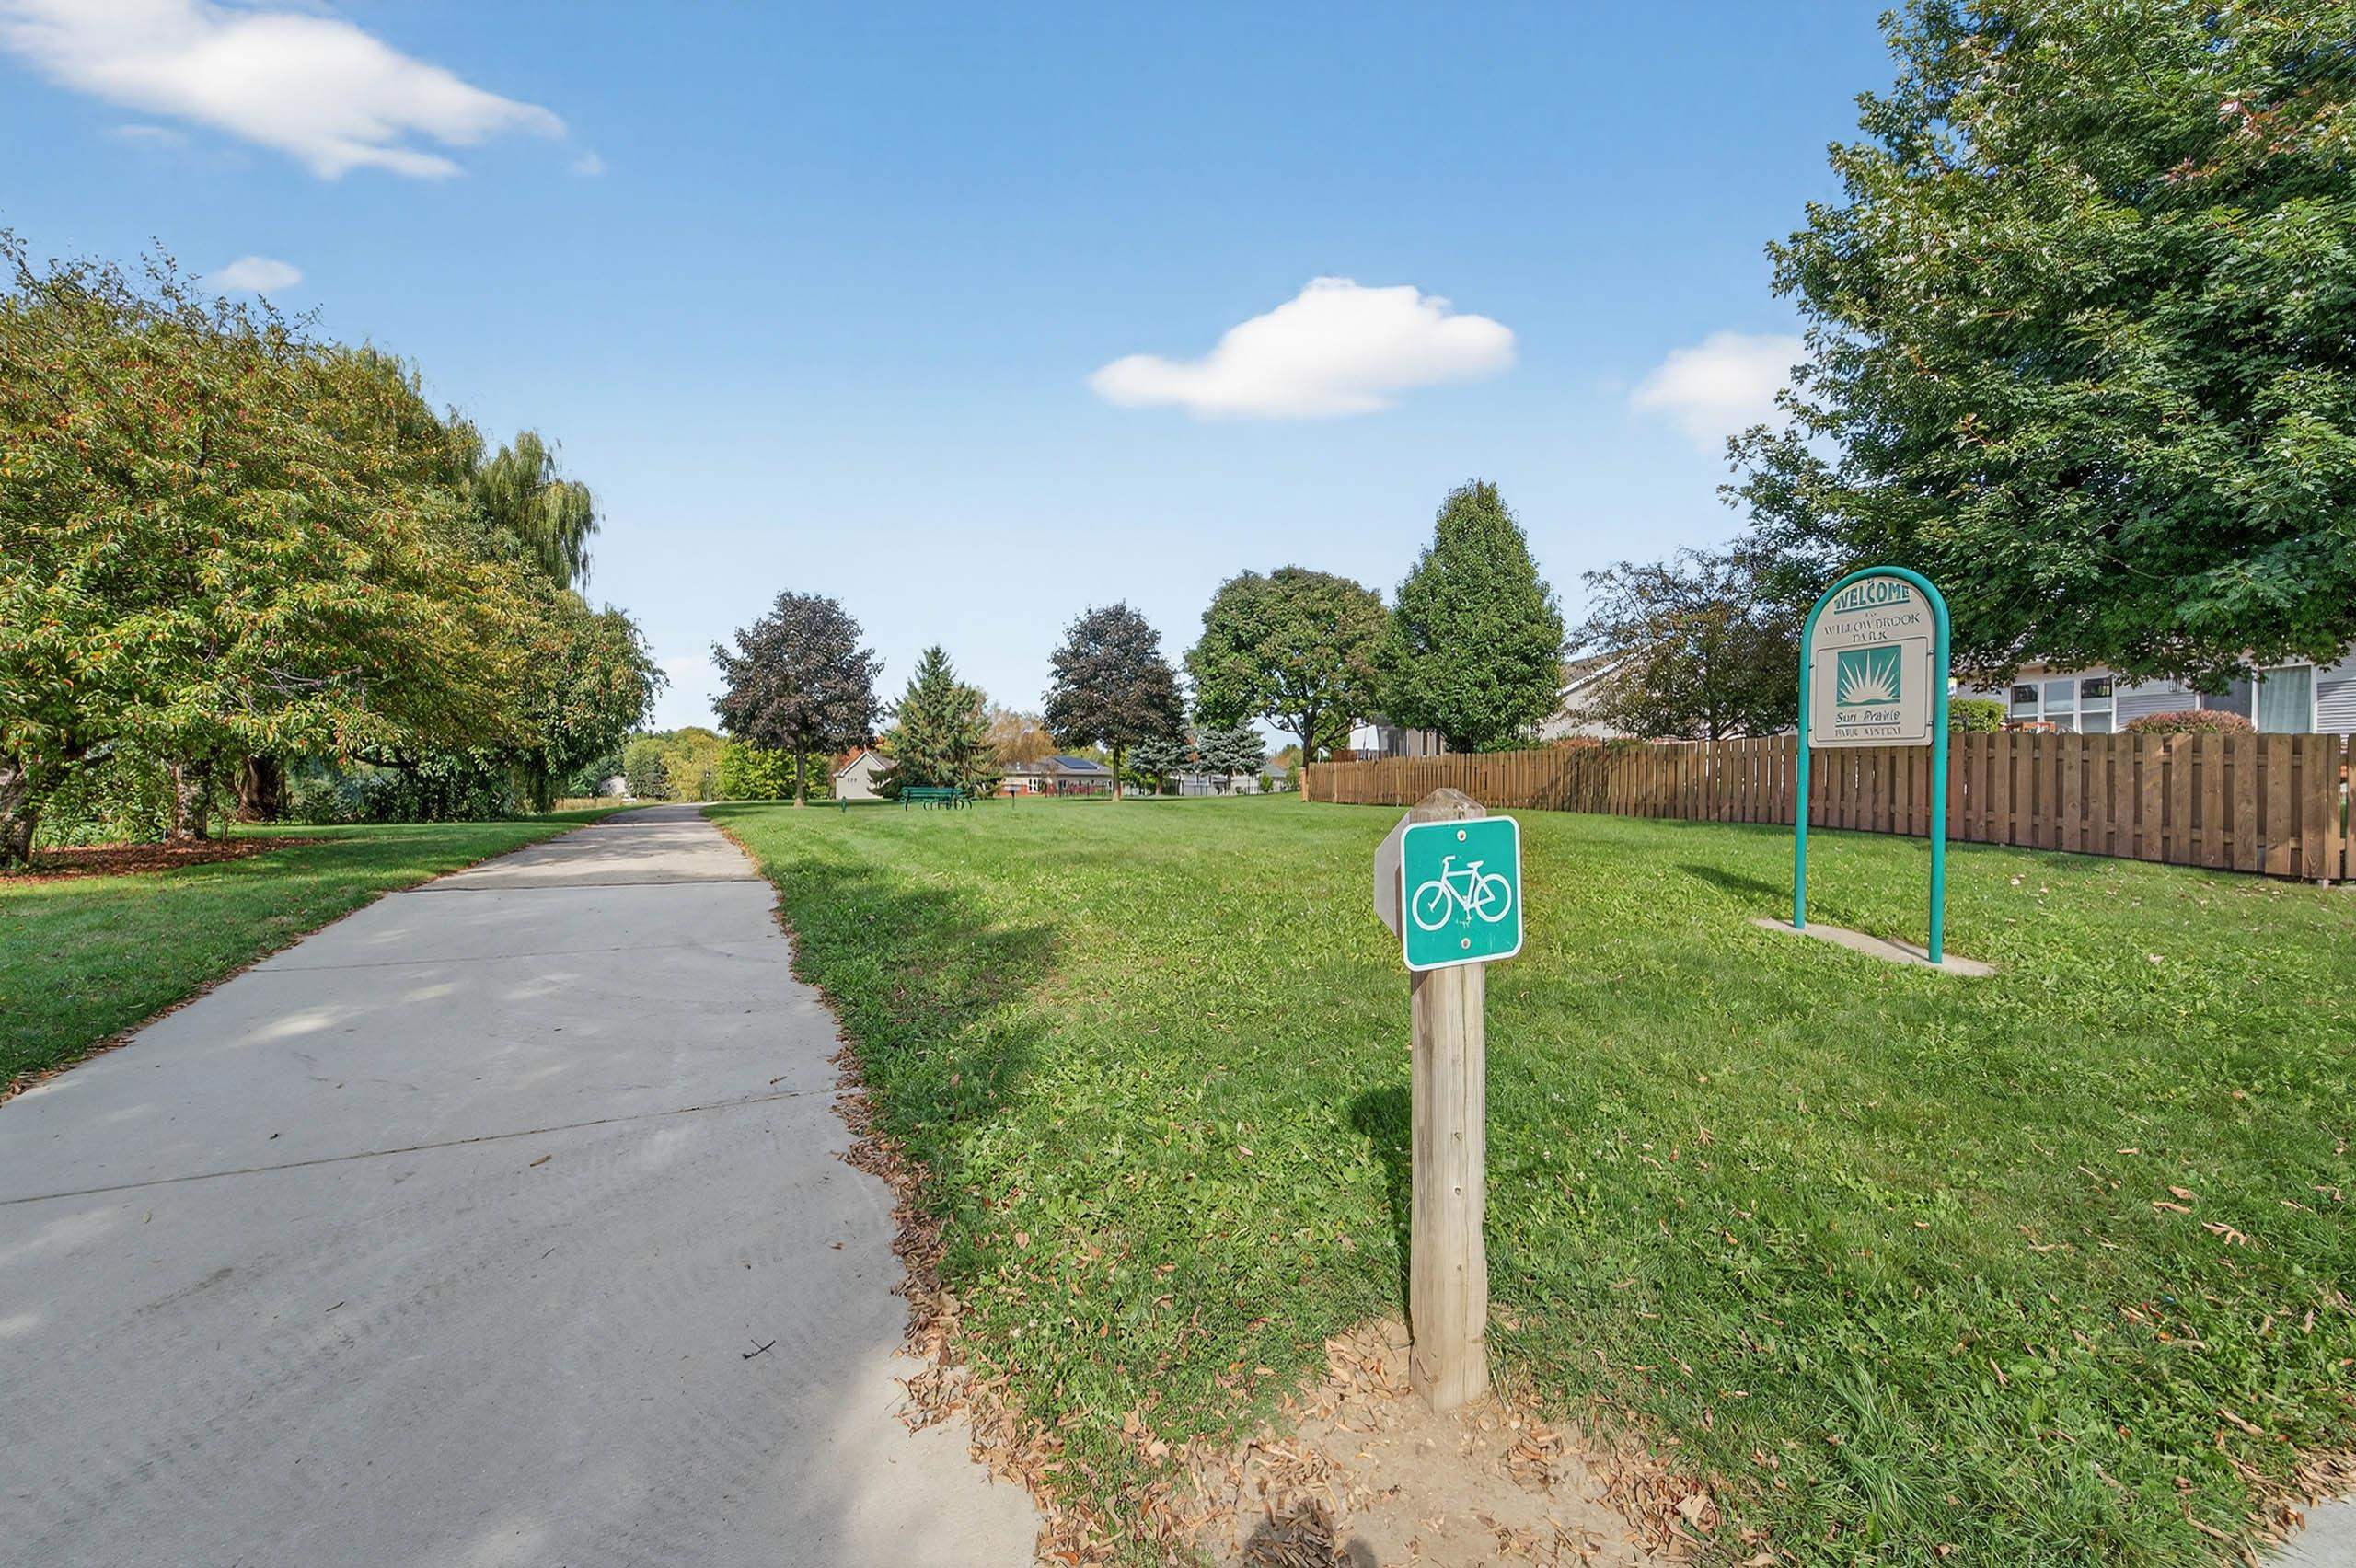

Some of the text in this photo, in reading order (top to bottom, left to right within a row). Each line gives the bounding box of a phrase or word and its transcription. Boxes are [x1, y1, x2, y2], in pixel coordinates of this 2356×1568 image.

[1834, 582, 1910, 609] WELCOME
[1853, 631, 1888, 643] PARK
[1836, 710, 1900, 723] Sun Prairie
